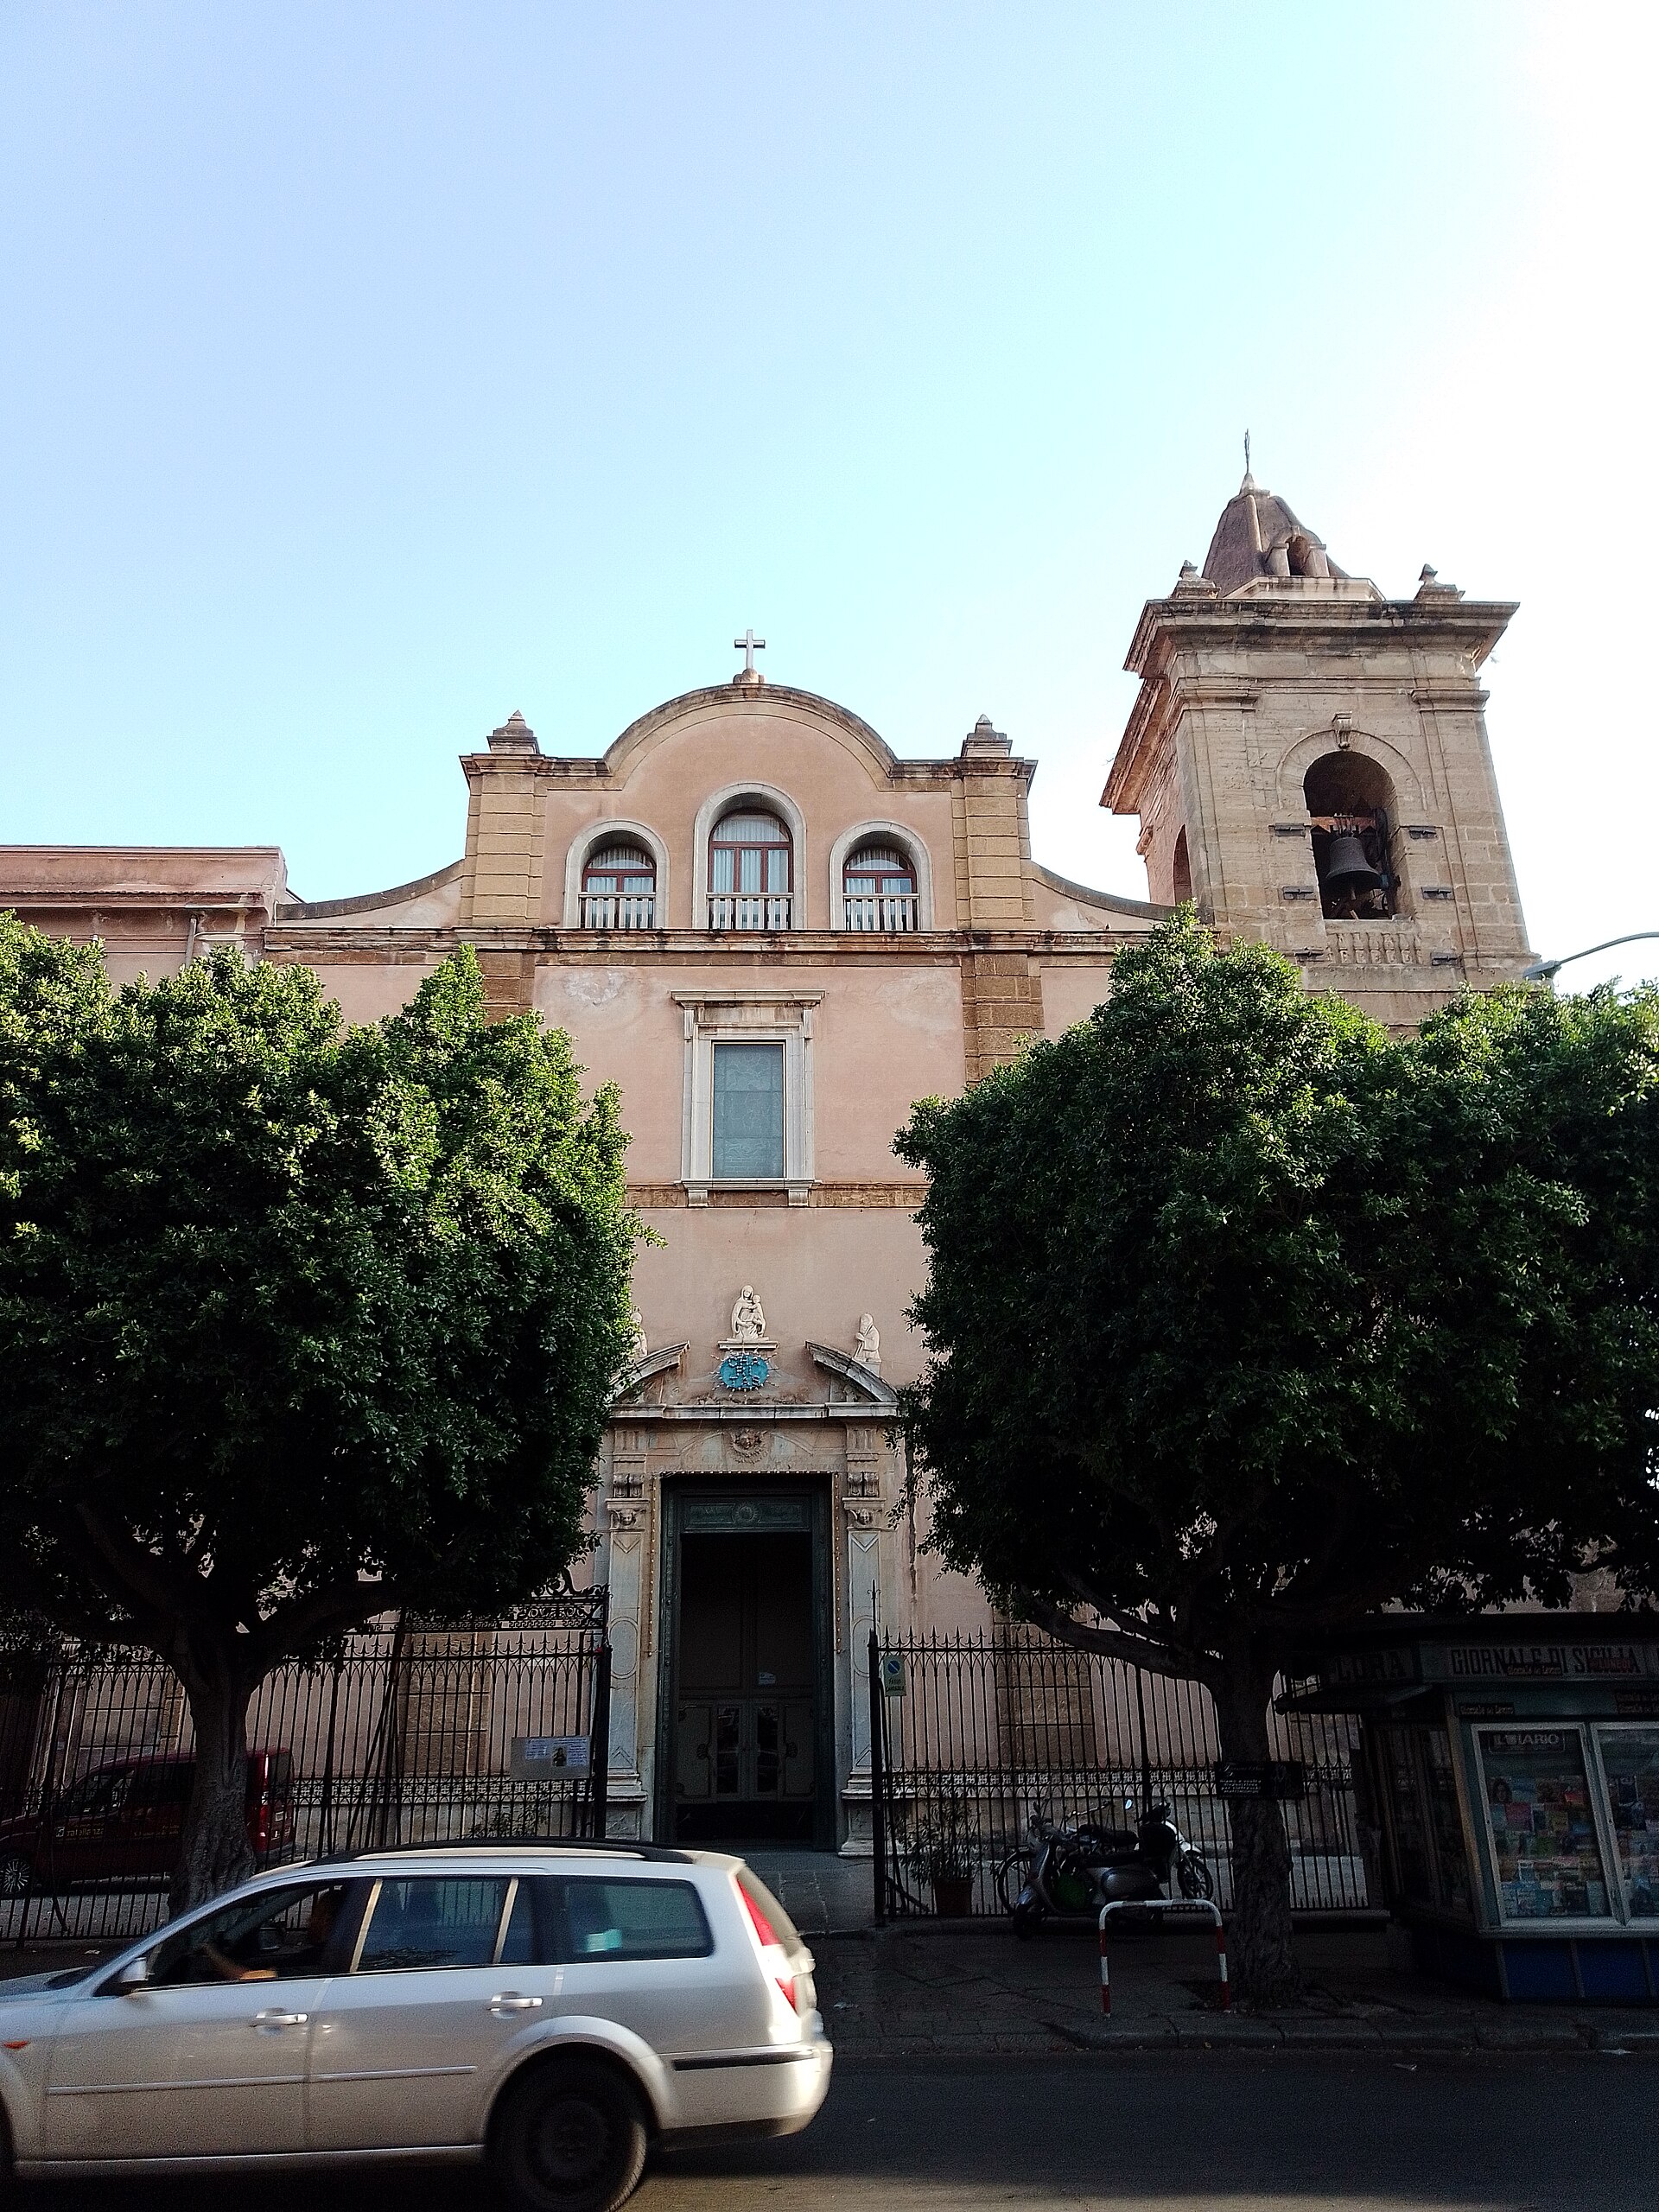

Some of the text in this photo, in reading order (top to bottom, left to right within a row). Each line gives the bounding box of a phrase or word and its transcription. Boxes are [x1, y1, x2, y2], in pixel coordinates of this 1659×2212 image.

[1451, 1647, 1641, 1675] GIORNALE DI SICILIA
